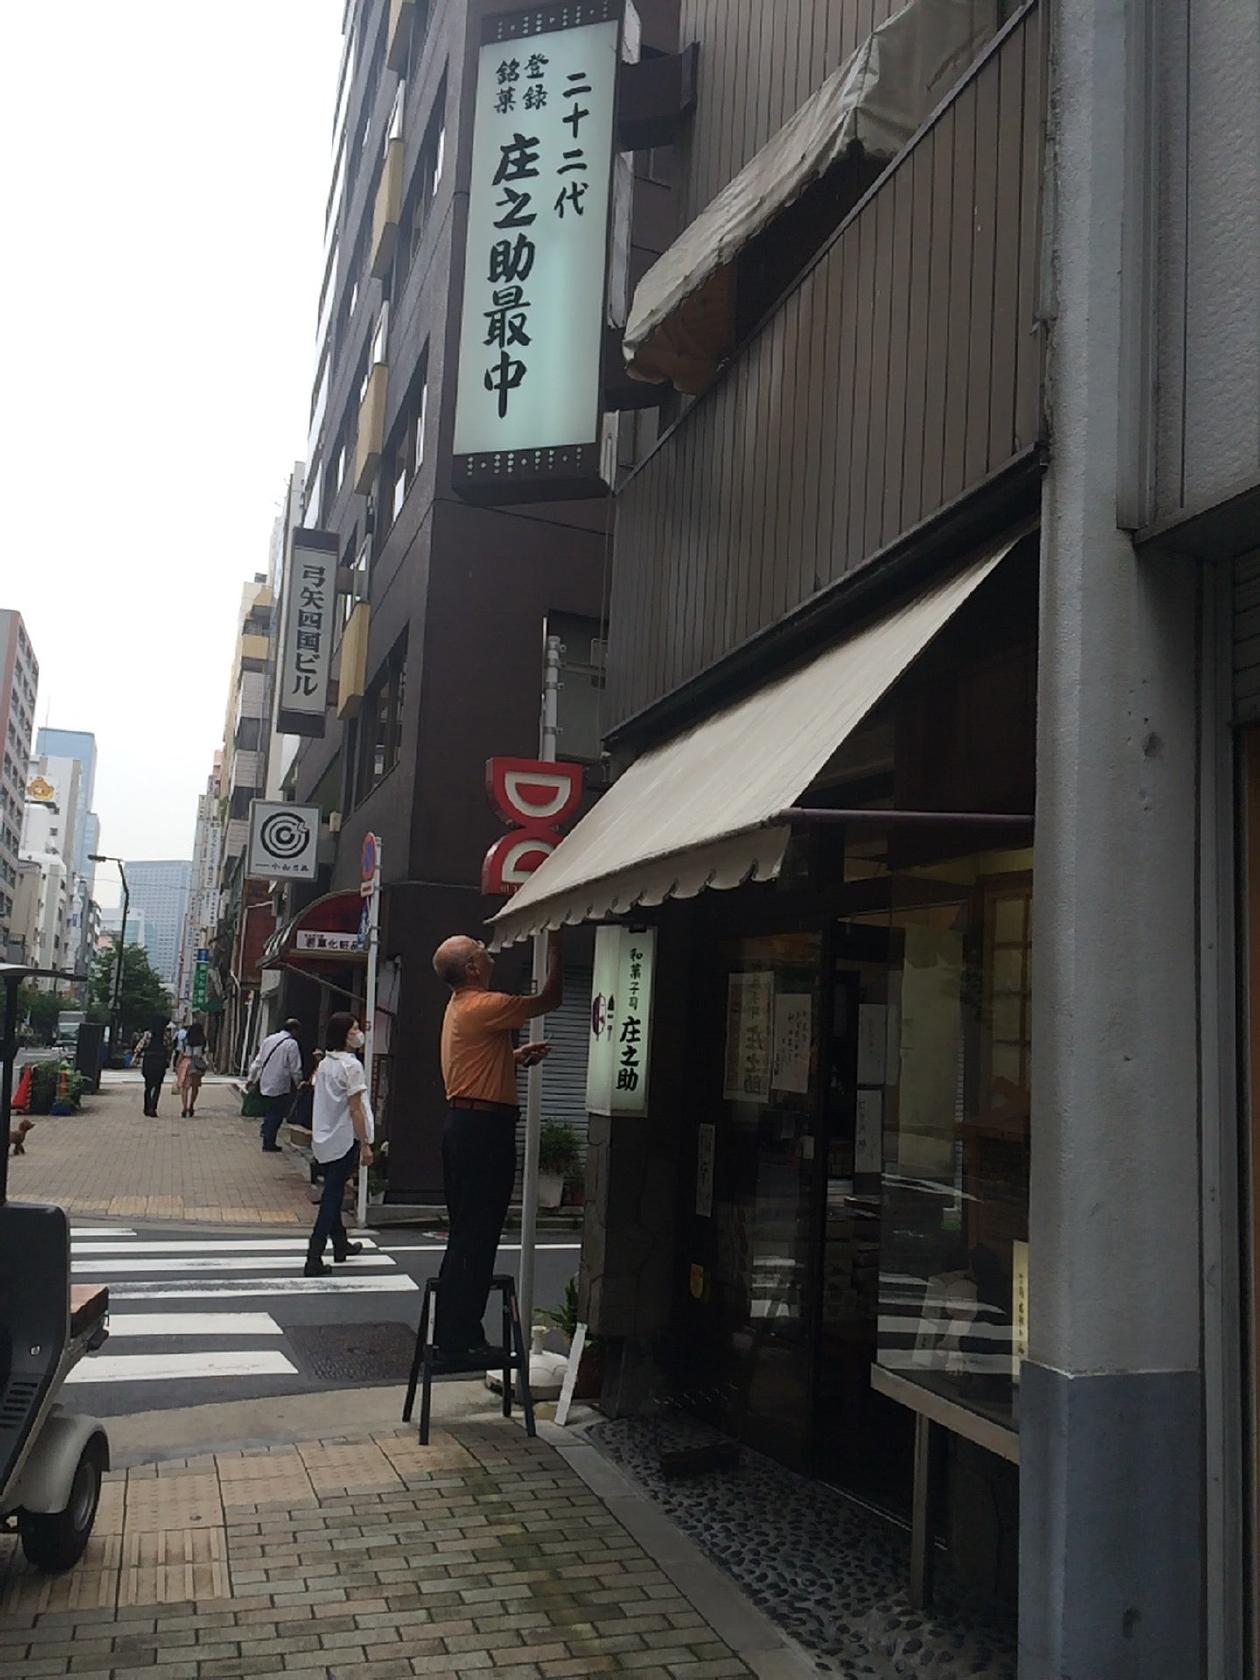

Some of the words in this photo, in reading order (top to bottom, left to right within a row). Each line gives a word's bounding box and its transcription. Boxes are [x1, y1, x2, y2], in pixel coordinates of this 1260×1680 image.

[493, 57, 521, 115] 銘菓
[522, 53, 550, 111] 登録
[554, 71, 592, 219] 二十二代
[483, 133, 541, 419] 庄之助最中
[292, 564, 327, 697] 弓矢四国ビル
[628, 947, 643, 1011] 和菓子司
[616, 1016, 642, 1091] 庄之助
